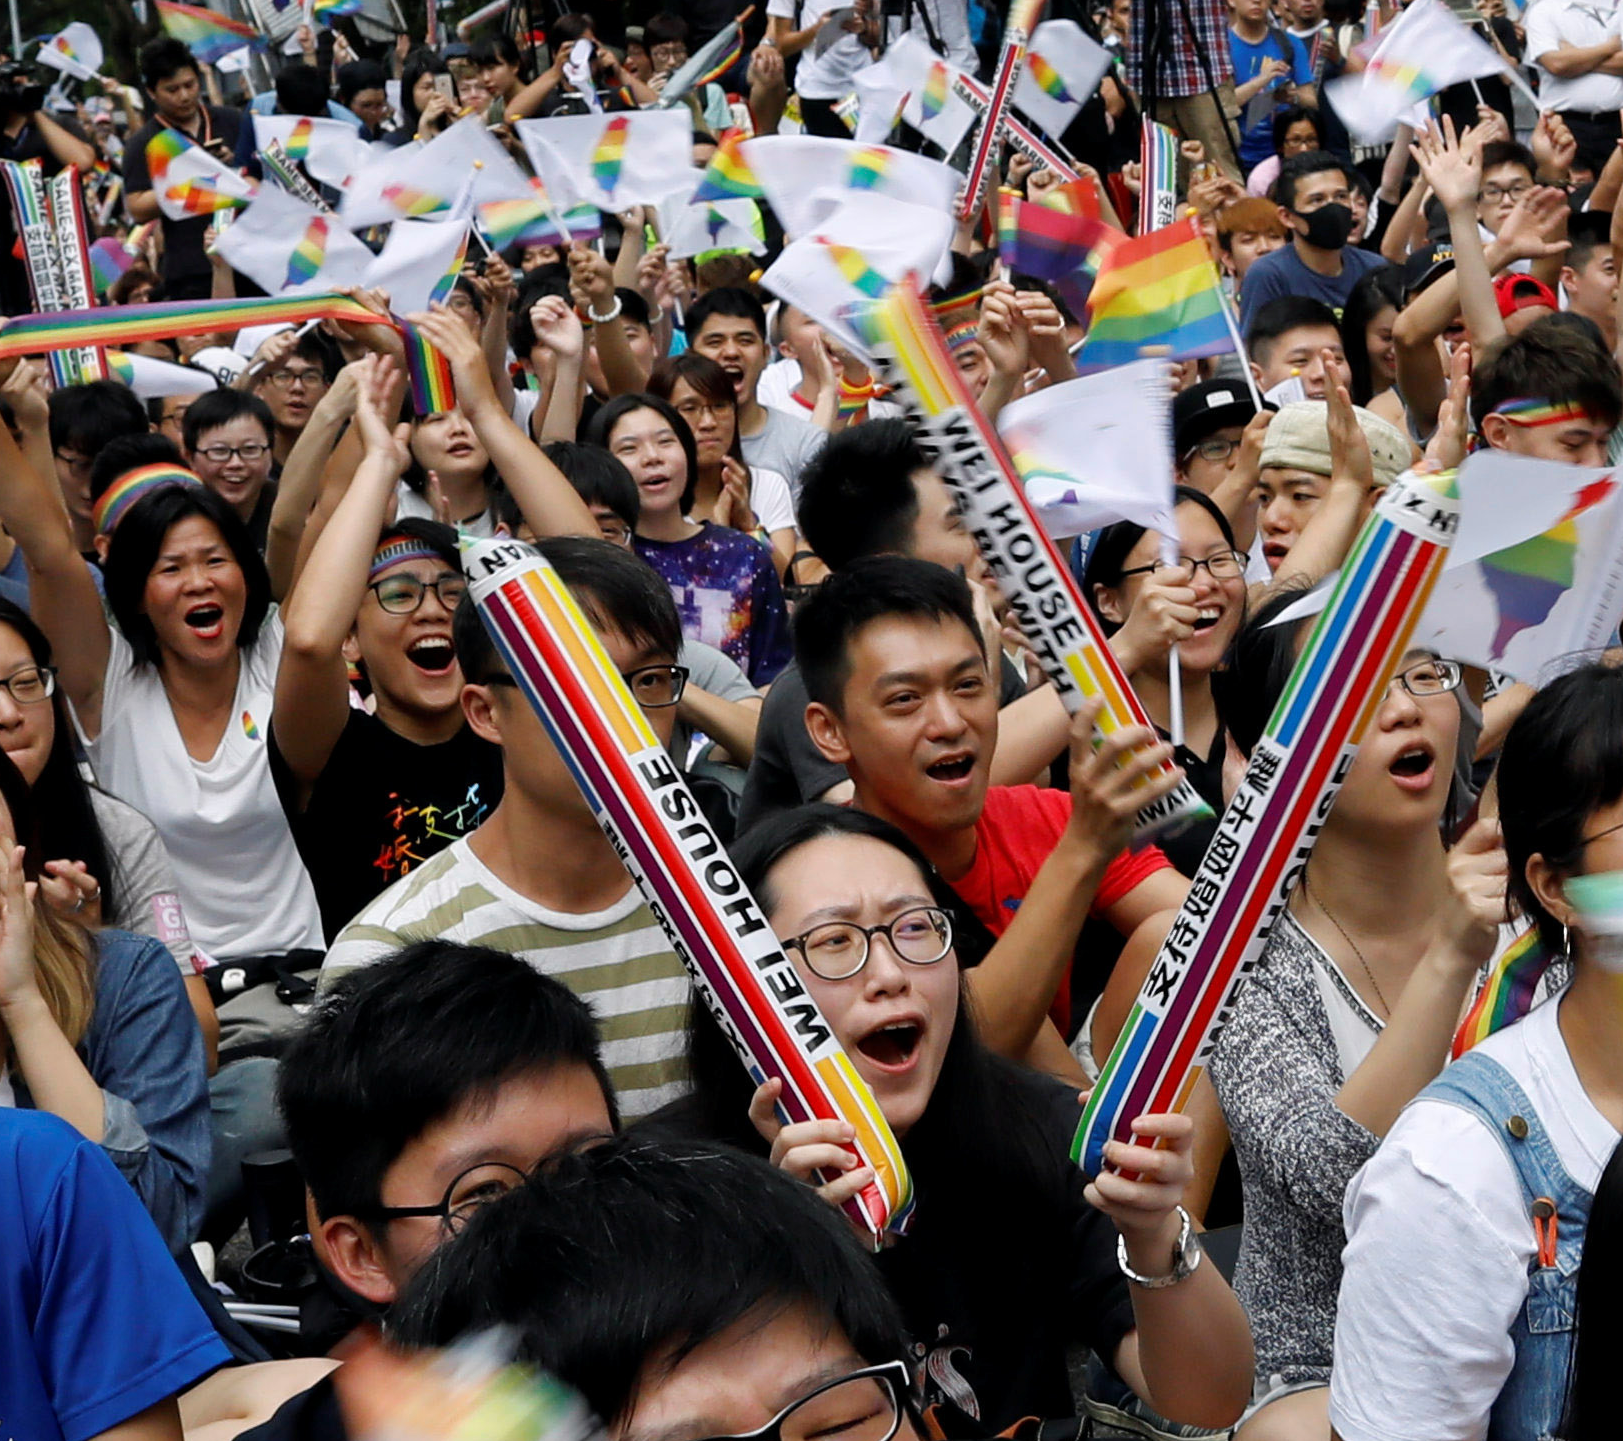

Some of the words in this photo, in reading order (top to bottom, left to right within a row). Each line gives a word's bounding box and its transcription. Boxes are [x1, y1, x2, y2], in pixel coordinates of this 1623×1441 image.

[988, 502, 1084, 649] HOUSE
[637, 753, 767, 939] HOUSE
[1143, 745, 1282, 1009] 支持婚姻平權
[755, 952, 833, 1055] WEI
